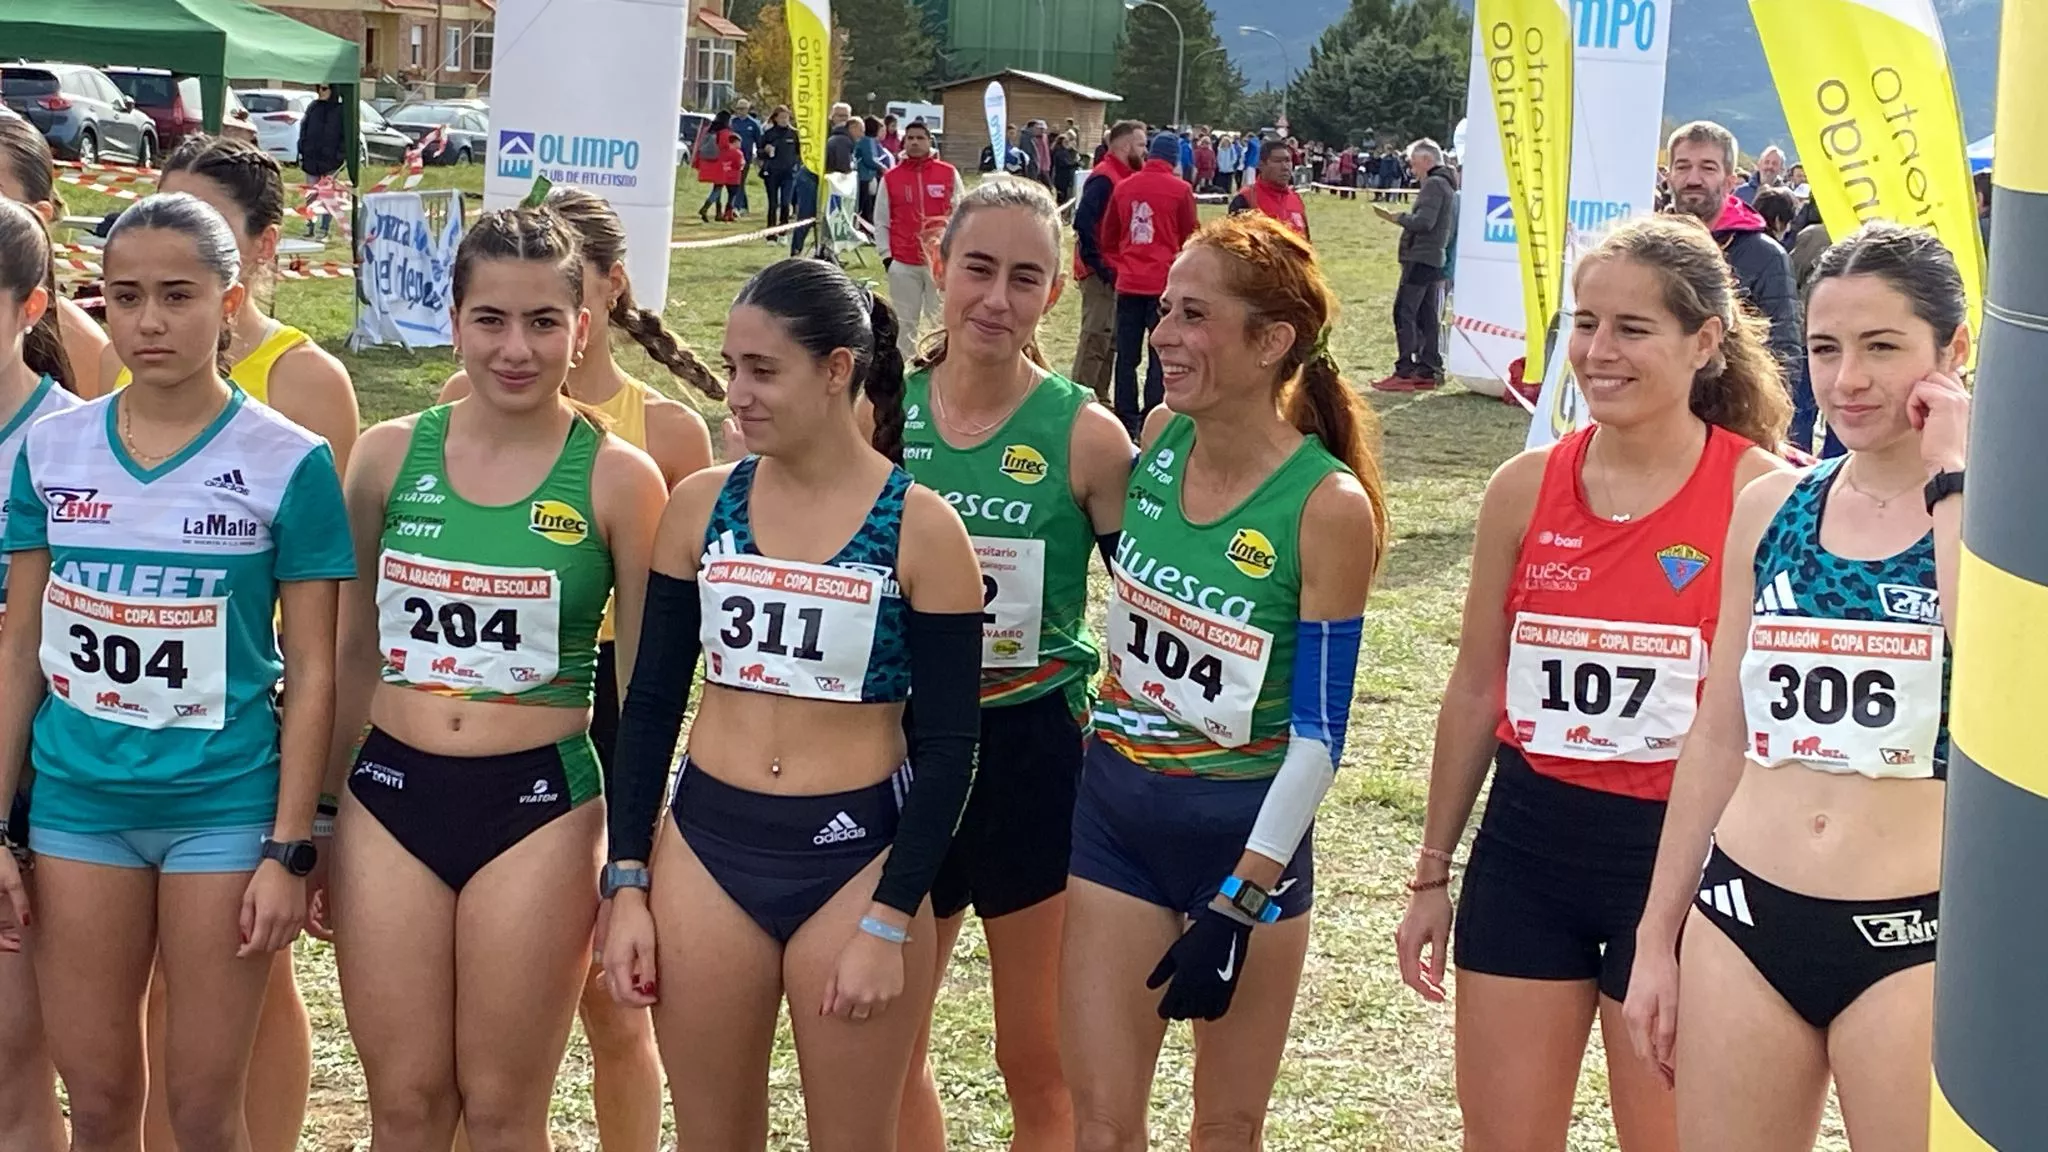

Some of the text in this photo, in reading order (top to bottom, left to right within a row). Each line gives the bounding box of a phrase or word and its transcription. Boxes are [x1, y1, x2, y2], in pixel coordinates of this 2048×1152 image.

[539, 134, 639, 170] OLIMPO
[566, 171, 579, 183] DE
[582, 172, 637, 187] ATLETISMO
[49, 492, 113, 519] ZENIT
[204, 480, 250, 496] adidas
[944, 492, 1033, 525] esca
[60, 561, 227, 598] ATLEET
[386, 561, 408, 581] COPA
[409, 567, 452, 589] ARAGÓN
[462, 575, 491, 594] COPA
[494, 578, 548, 595] ESCOLAR
[708, 566, 728, 580] COPA
[730, 566, 775, 586] ARAGÓN
[784, 572, 813, 592] COPA
[815, 576, 868, 600] ESCOLAR
[1116, 530, 1256, 624] Huesca
[50, 587, 73, 608] COPA
[73, 599, 114, 621] ARAGÓN
[124, 609, 157, 625] COPA
[159, 610, 214, 625] ESCOLAR
[404, 597, 521, 651] 204
[1132, 592, 1171, 622] ARAGÓN
[1179, 615, 1206, 637] COPA
[1207, 627, 1260, 656] ESCOLAR
[720, 596, 824, 661] 311
[1519, 627, 1543, 642] COPA
[1546, 628, 1588, 648] ARAGÓN
[1600, 633, 1629, 651] COPA
[1632, 637, 1688, 656] ESCOLAR
[1754, 629, 1772, 646] COPA
[1774, 629, 1820, 649] ARAGÓN
[1831, 633, 1864, 653] COPA
[1867, 636, 1928, 656] ESCOLAR
[69, 624, 188, 689] 304
[1127, 612, 1223, 702] 104
[1542, 659, 1656, 718] 107
[1769, 663, 1895, 728] 306
[519, 793, 558, 804] VIATOR
[813, 827, 866, 845] adidas
